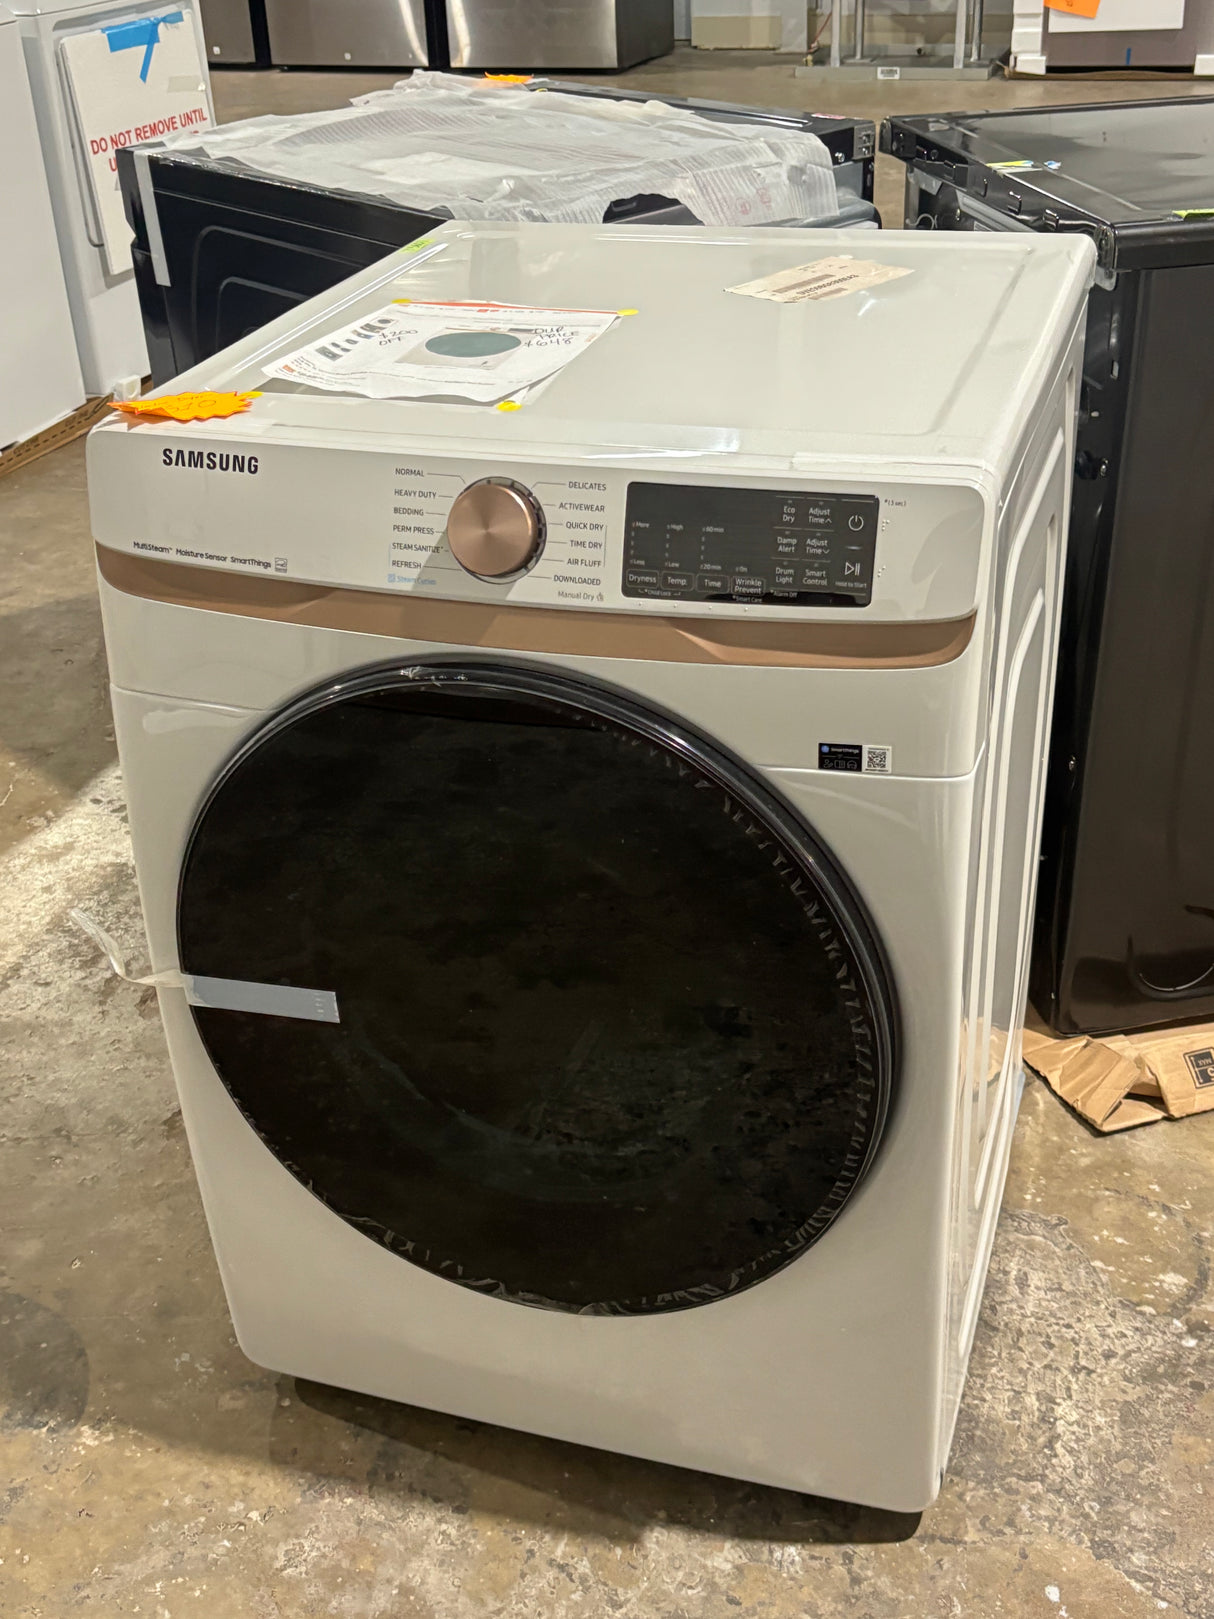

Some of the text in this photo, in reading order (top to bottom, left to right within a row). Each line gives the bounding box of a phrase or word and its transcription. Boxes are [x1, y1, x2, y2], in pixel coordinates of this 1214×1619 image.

[90, 108, 207, 155] DO NOT REMOVE UNTIL
[162, 448, 259, 475] SAMSUNG
[395, 467, 425, 477] NORMAL
[568, 481, 607, 491] DELICATES
[394, 488, 437, 499] HEAVY DUTY
[393, 506, 424, 516] BEDDING
[558, 502, 605, 513] ACTIVEWEAR
[783, 505, 796, 514] Eco
[808, 507, 831, 517] Adjust
[782, 514, 795, 524] Dry
[808, 516, 825, 524] Time
[392, 524, 435, 535] PERM PRESS
[565, 521, 604, 531] QUICK DRY
[392, 542, 413, 551] STEAM
[569, 539, 603, 550] TIME DRY
[777, 536, 797, 547] Damp
[806, 538, 828, 549] Adjust
[777, 545, 795, 554] Alert
[806, 547, 822, 556] Time
[175, 548, 204, 559] Moisture
[204, 552, 227, 562] Sensor
[230, 556, 272, 569] SmartThings
[566, 558, 602, 568] AIR FLUFF
[391, 559, 422, 569] REFRESH
[775, 567, 795, 576] Drum
[805, 569, 826, 578] Smart
[553, 574, 601, 586] DOWNLOADED
[628, 573, 657, 584] Dryness
[704, 578, 722, 587] Time
[735, 577, 762, 587] Wrinkle
[775, 575, 793, 585] Light
[802, 577, 828, 587] Control
[557, 590, 595, 601] Manual Dry
[734, 586, 762, 595] Prevent
